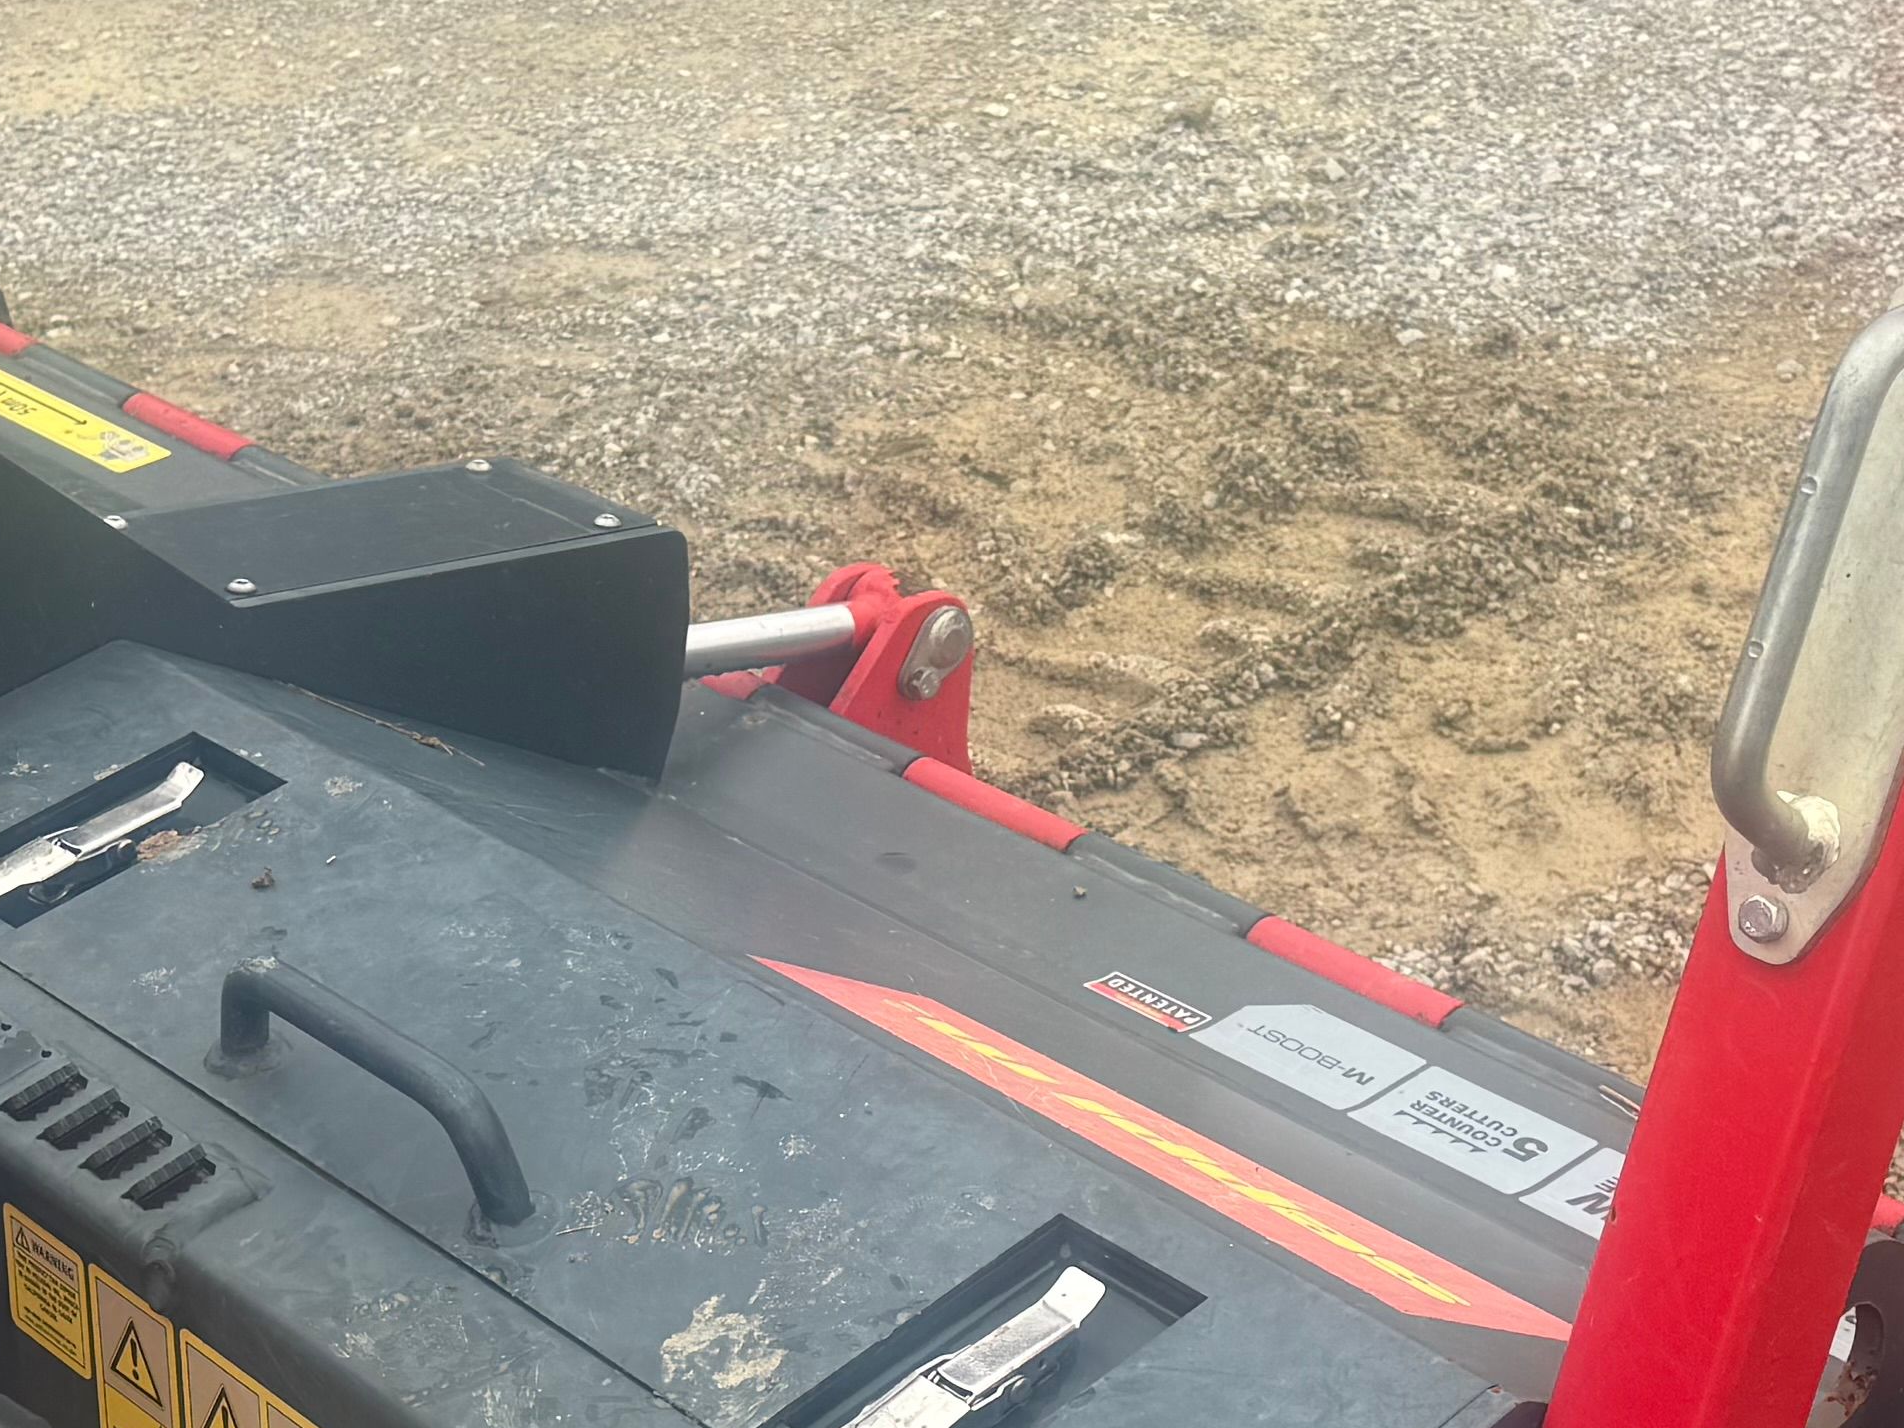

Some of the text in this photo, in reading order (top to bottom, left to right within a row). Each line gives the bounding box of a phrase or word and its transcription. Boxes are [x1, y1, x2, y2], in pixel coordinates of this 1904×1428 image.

[1, 397, 38, 415] 50m
[1107, 975, 1199, 1025] PATENTED
[1246, 1021, 1376, 1087] M-BOOST
[1409, 1099, 1552, 1163] 5 COUNTER
[1426, 1089, 1521, 1138] CUTTERS
